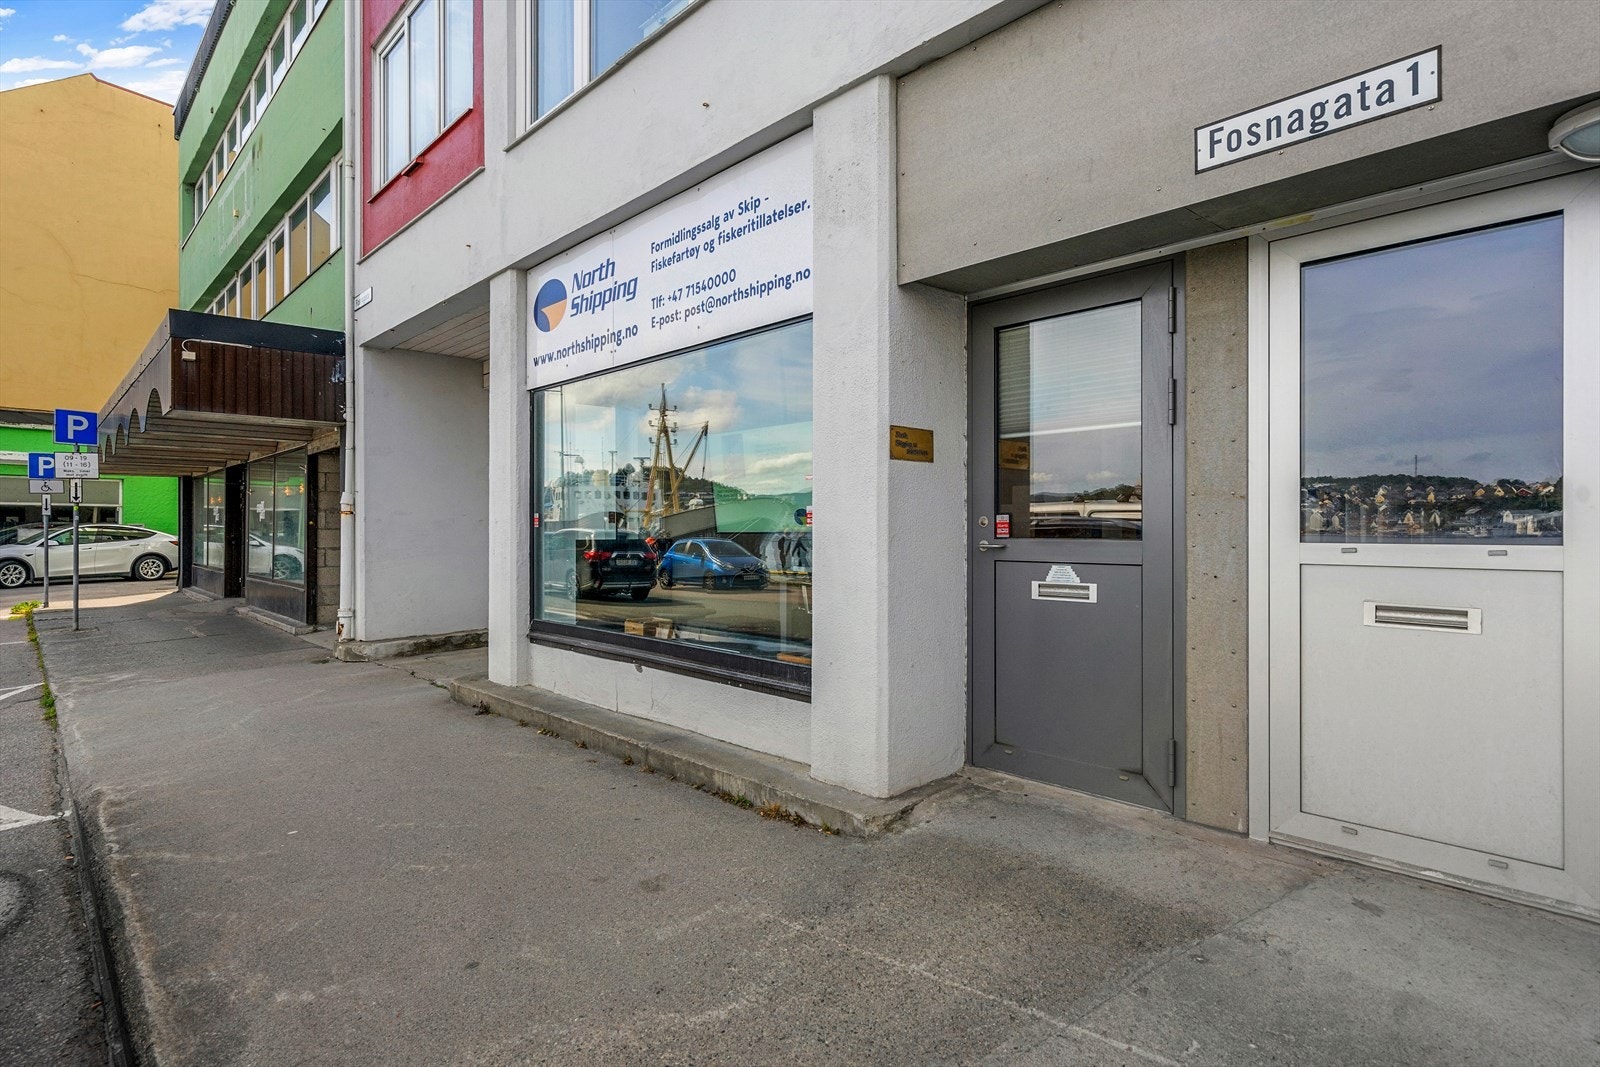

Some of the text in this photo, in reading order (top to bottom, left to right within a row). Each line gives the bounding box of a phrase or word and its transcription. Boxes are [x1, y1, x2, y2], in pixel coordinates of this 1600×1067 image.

[1209, 60, 1419, 159] Fosnagata 1
[651, 215, 720, 254] Formidlingssalg
[723, 209, 735, 223] av
[738, 196, 761, 217] Skip
[651, 198, 811, 273] Fiskefartøy og fiskeritillatelser.
[570, 276, 638, 317] Shipping
[572, 258, 616, 293] North
[651, 268, 737, 310] Tlf: +47 71540000
[651, 267, 811, 329] E-post: post@northshipping.no
[533, 324, 638, 367] www.northshipping.no
[67, 414, 89, 440] P
[38, 456, 54, 477] P
